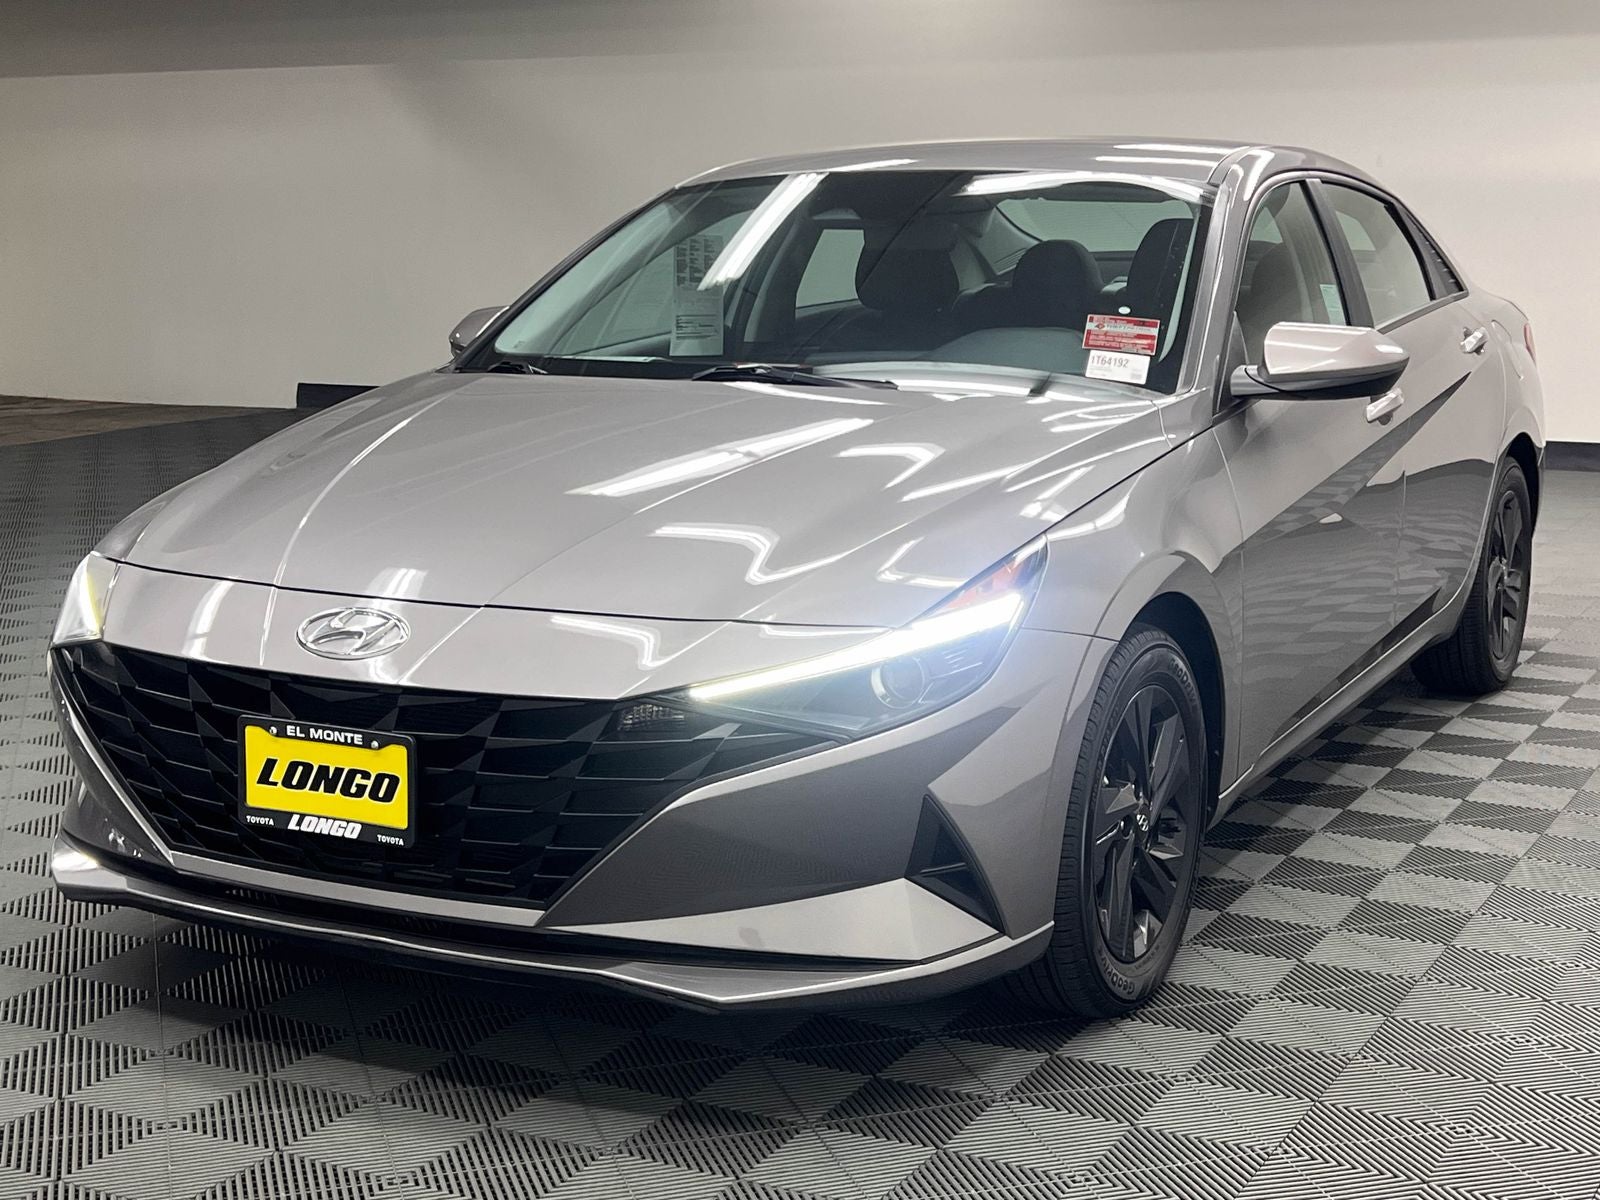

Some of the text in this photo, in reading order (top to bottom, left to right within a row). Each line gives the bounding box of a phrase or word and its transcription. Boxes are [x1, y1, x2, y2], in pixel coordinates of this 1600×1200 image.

[286, 725, 363, 745] EL MONTE
[256, 757, 401, 803] LONGO
[246, 815, 275, 826] TOYOTA
[287, 814, 362, 839] LONGO
[377, 834, 404, 846] TOYOTA
